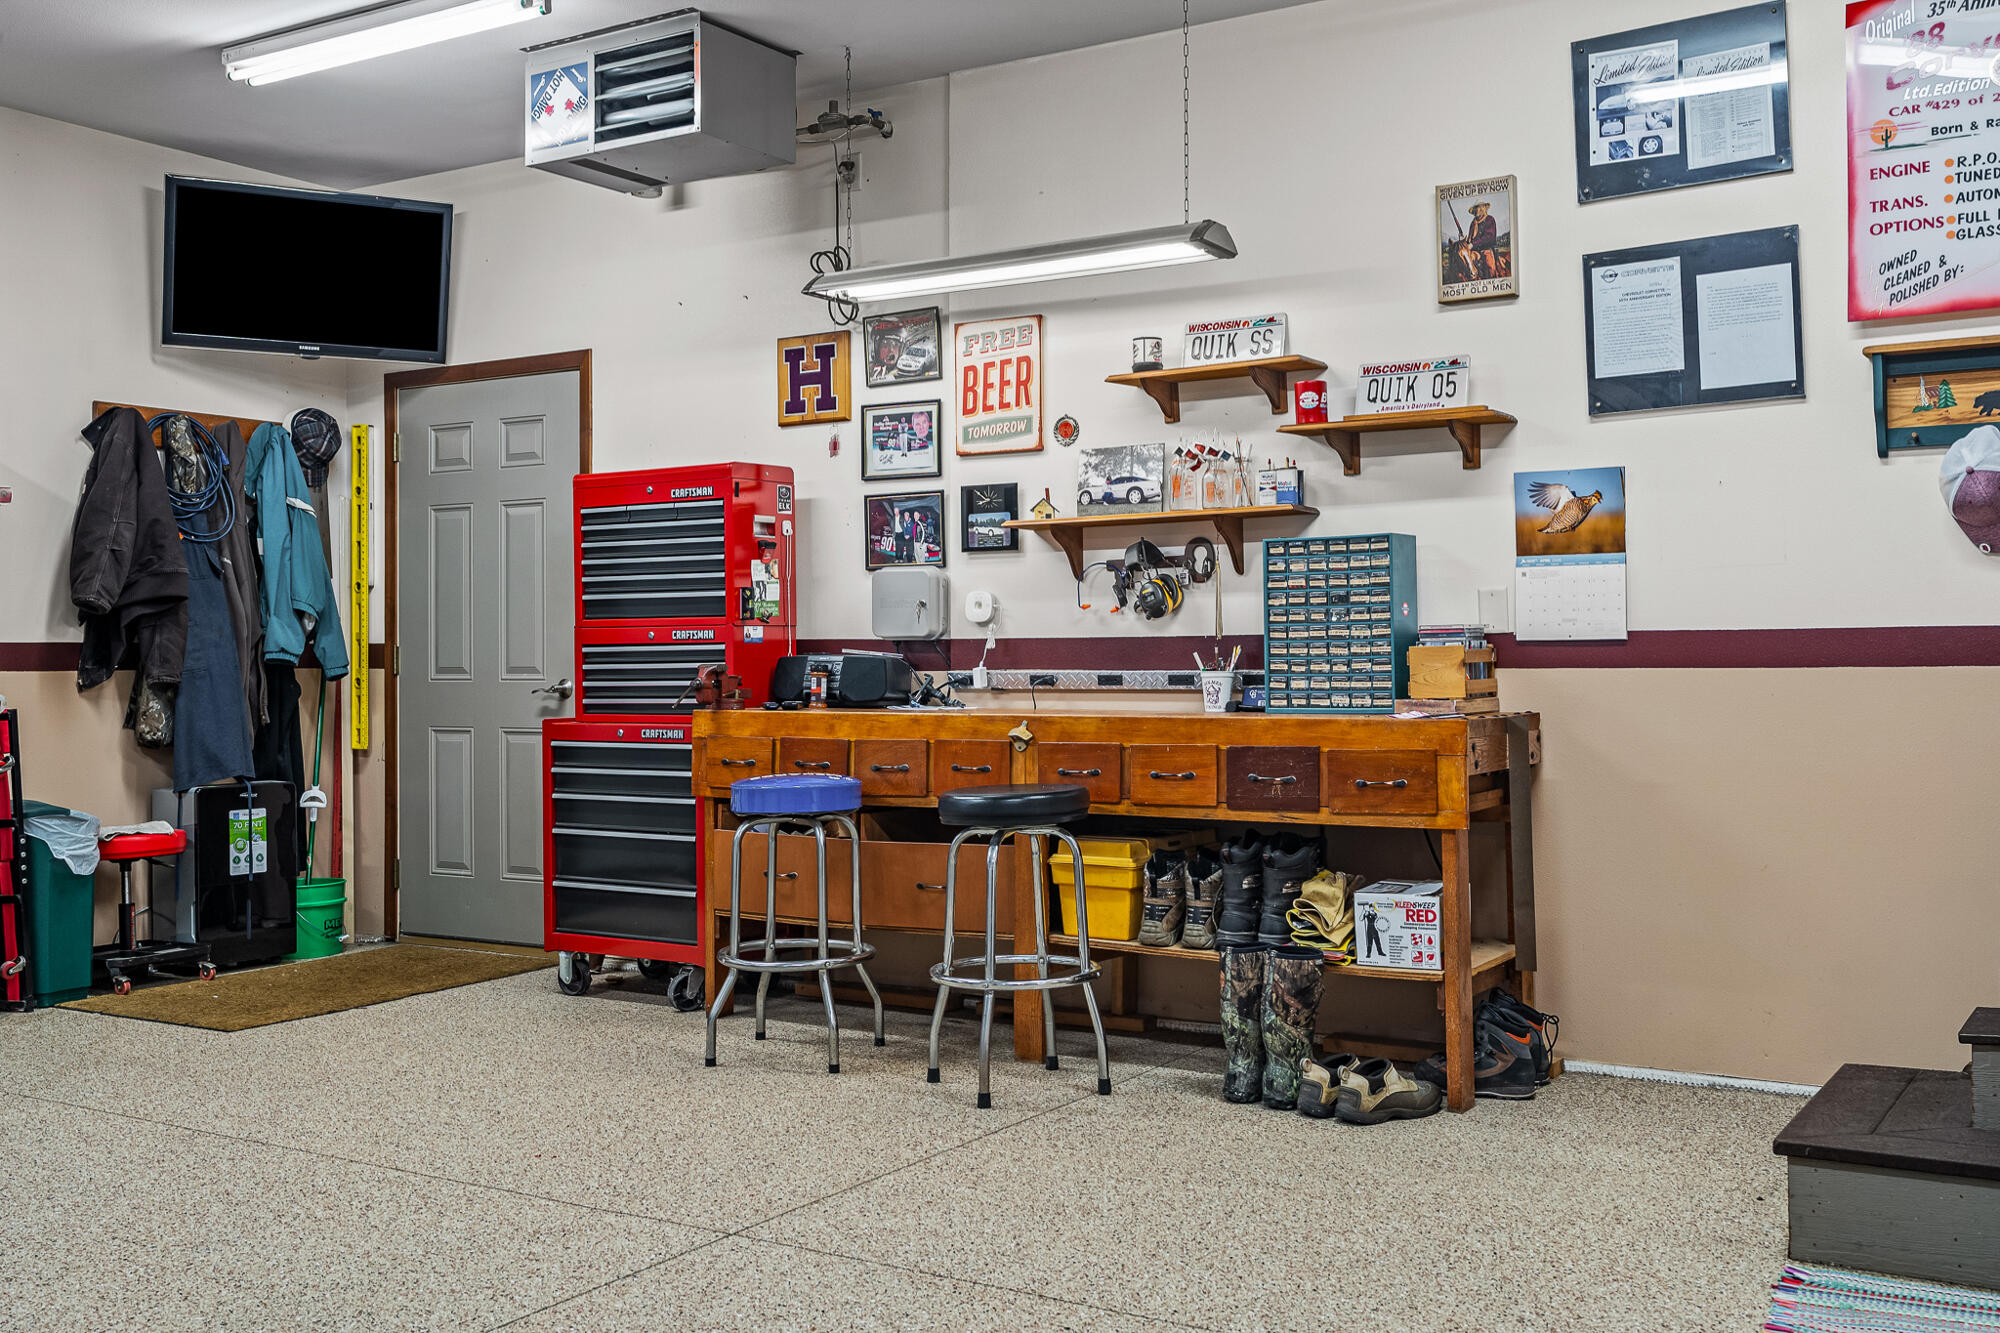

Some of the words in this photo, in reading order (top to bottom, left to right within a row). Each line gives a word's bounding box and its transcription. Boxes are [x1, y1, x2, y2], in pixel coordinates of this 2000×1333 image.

[1865, 0, 1915, 43] Original
[1593, 55, 1640, 86] Limited
[1638, 53, 1676, 75] Edition
[1730, 55, 1764, 73] Edition
[550, 71, 566, 94] HOT
[532, 91, 553, 119] DAWG
[1888, 103, 1921, 117] CAR
[1925, 98, 1961, 111] #429
[1968, 94, 1985, 106] of
[1931, 122, 1963, 136] Born
[1970, 120, 1979, 131] &
[1869, 160, 1931, 181] ENGINE
[1440, 190, 1464, 200] GIVEN
[1465, 189, 1477, 197] UP
[1477, 186, 1488, 194] BY
[1489, 183, 1509, 193] NOW
[1869, 194, 1929, 214] TRANS.
[1869, 215, 1945, 236] OPTIONS
[1957, 210, 1991, 225] FULL
[1879, 249, 1917, 276] OWNED
[1883, 260, 1931, 291] CLEANED
[1939, 254, 1948, 269] &
[1442, 288, 1466, 298] MOST
[1470, 286, 1488, 294] OLD
[1492, 282, 1512, 292] MEN
[1889, 274, 1939, 306] POLISHED
[1944, 264, 1964, 283] BY:
[1188, 319, 1241, 333] WISCONSIN
[962, 323, 1033, 357] FREE
[1191, 332, 1238, 360] QUIK
[1249, 328, 1274, 356] SS
[872, 365, 887, 380] 71
[1362, 362, 1421, 375] WISCONSIN
[783, 342, 837, 416] H
[962, 355, 1034, 418] BEER
[1367, 375, 1418, 403] QUIK
[1432, 371, 1457, 399] 05
[1380, 404, 1410, 412] America's
[1411, 402, 1441, 410] Dairyland
[967, 419, 1027, 441] TOMORROW
[671, 486, 714, 498] CRAFTSMAN
[778, 502, 791, 510] ELK
[880, 536, 892, 552] 90
[672, 629, 715, 641] CRAFTSMAN
[641, 728, 684, 740] CRAFTSMAN
[233, 821, 243, 829] 70
[1406, 909, 1437, 922] RED
